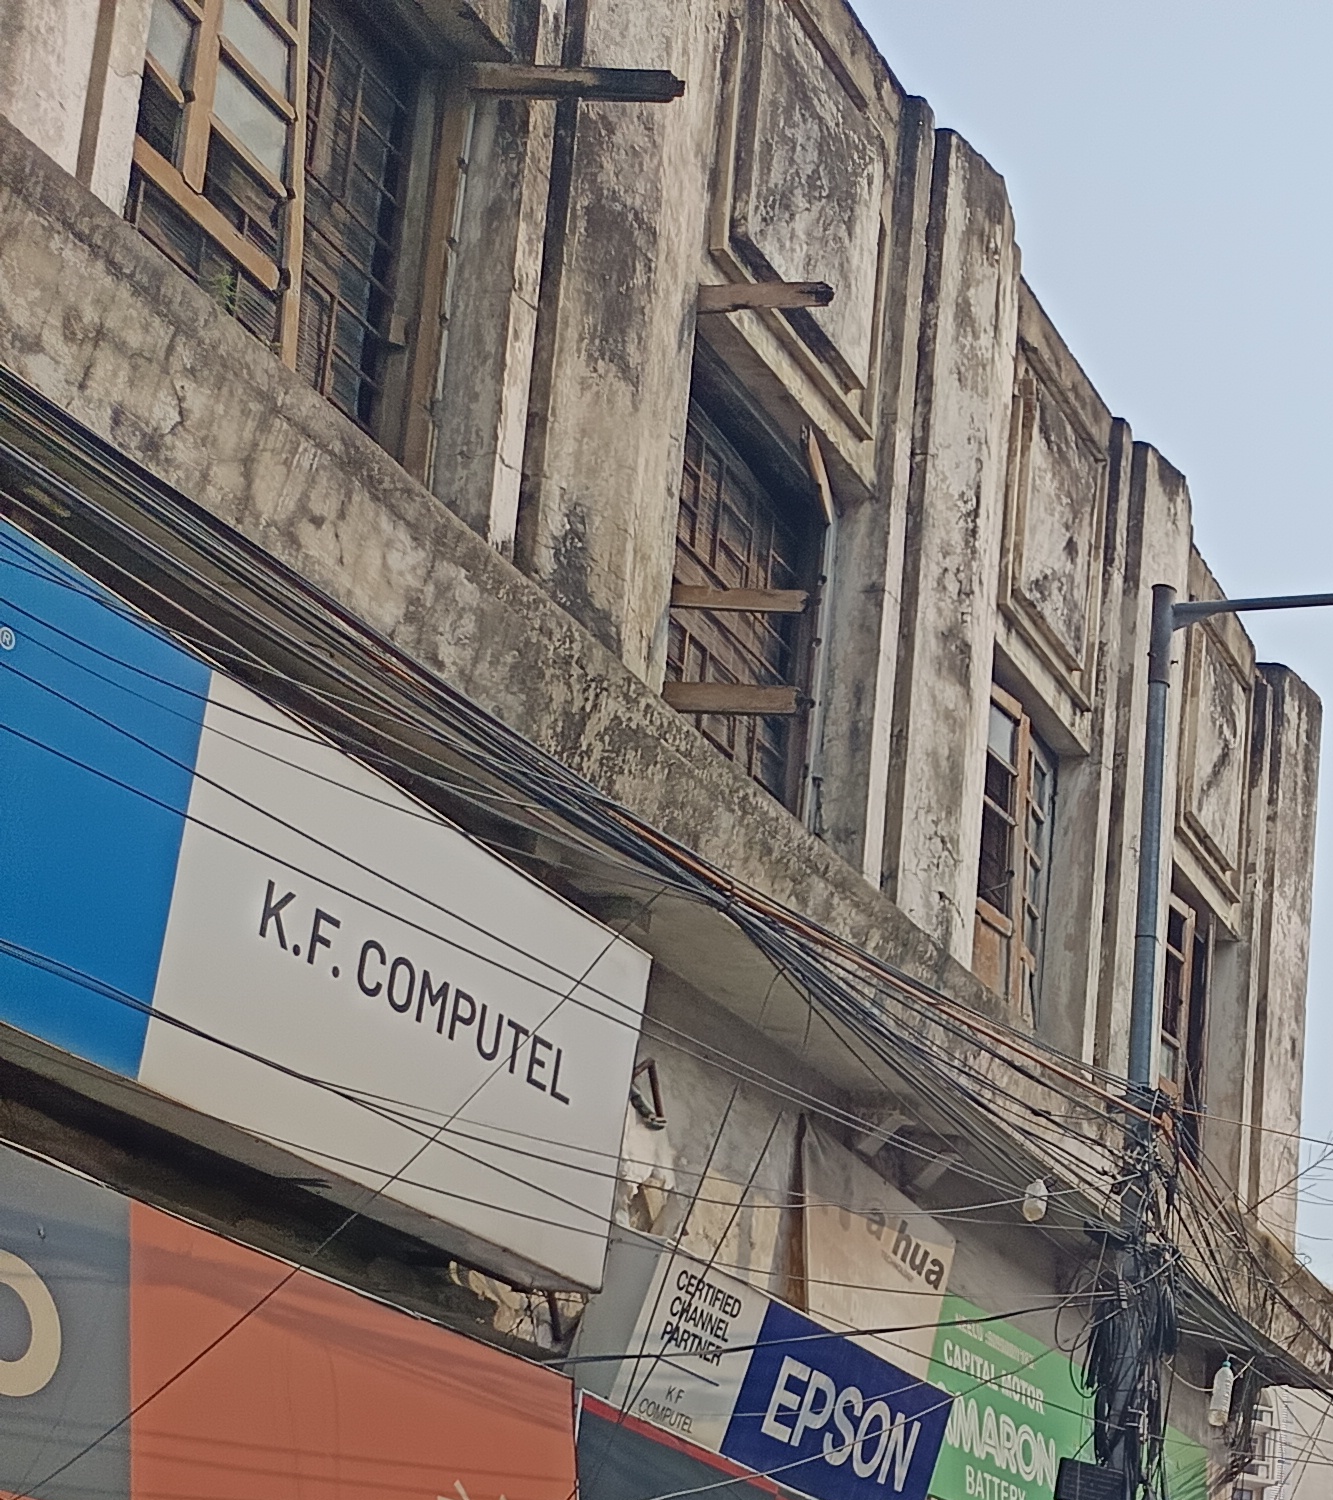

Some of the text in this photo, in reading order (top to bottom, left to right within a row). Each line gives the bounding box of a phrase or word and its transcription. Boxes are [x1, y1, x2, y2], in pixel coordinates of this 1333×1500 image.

[259, 879, 571, 1106] K.F. COMPUTEL
[677, 1270, 742, 1319] CERTIFIED
[660, 1321, 723, 1367] PARTNER
[670, 1296, 729, 1343] CHANNEL
[943, 1339, 999, 1391] CAPITAL
[1001, 1370, 1045, 1415] MOTOR
[638, 1397, 693, 1434] COMPUTEL
[761, 1355, 922, 1493] EPSON
